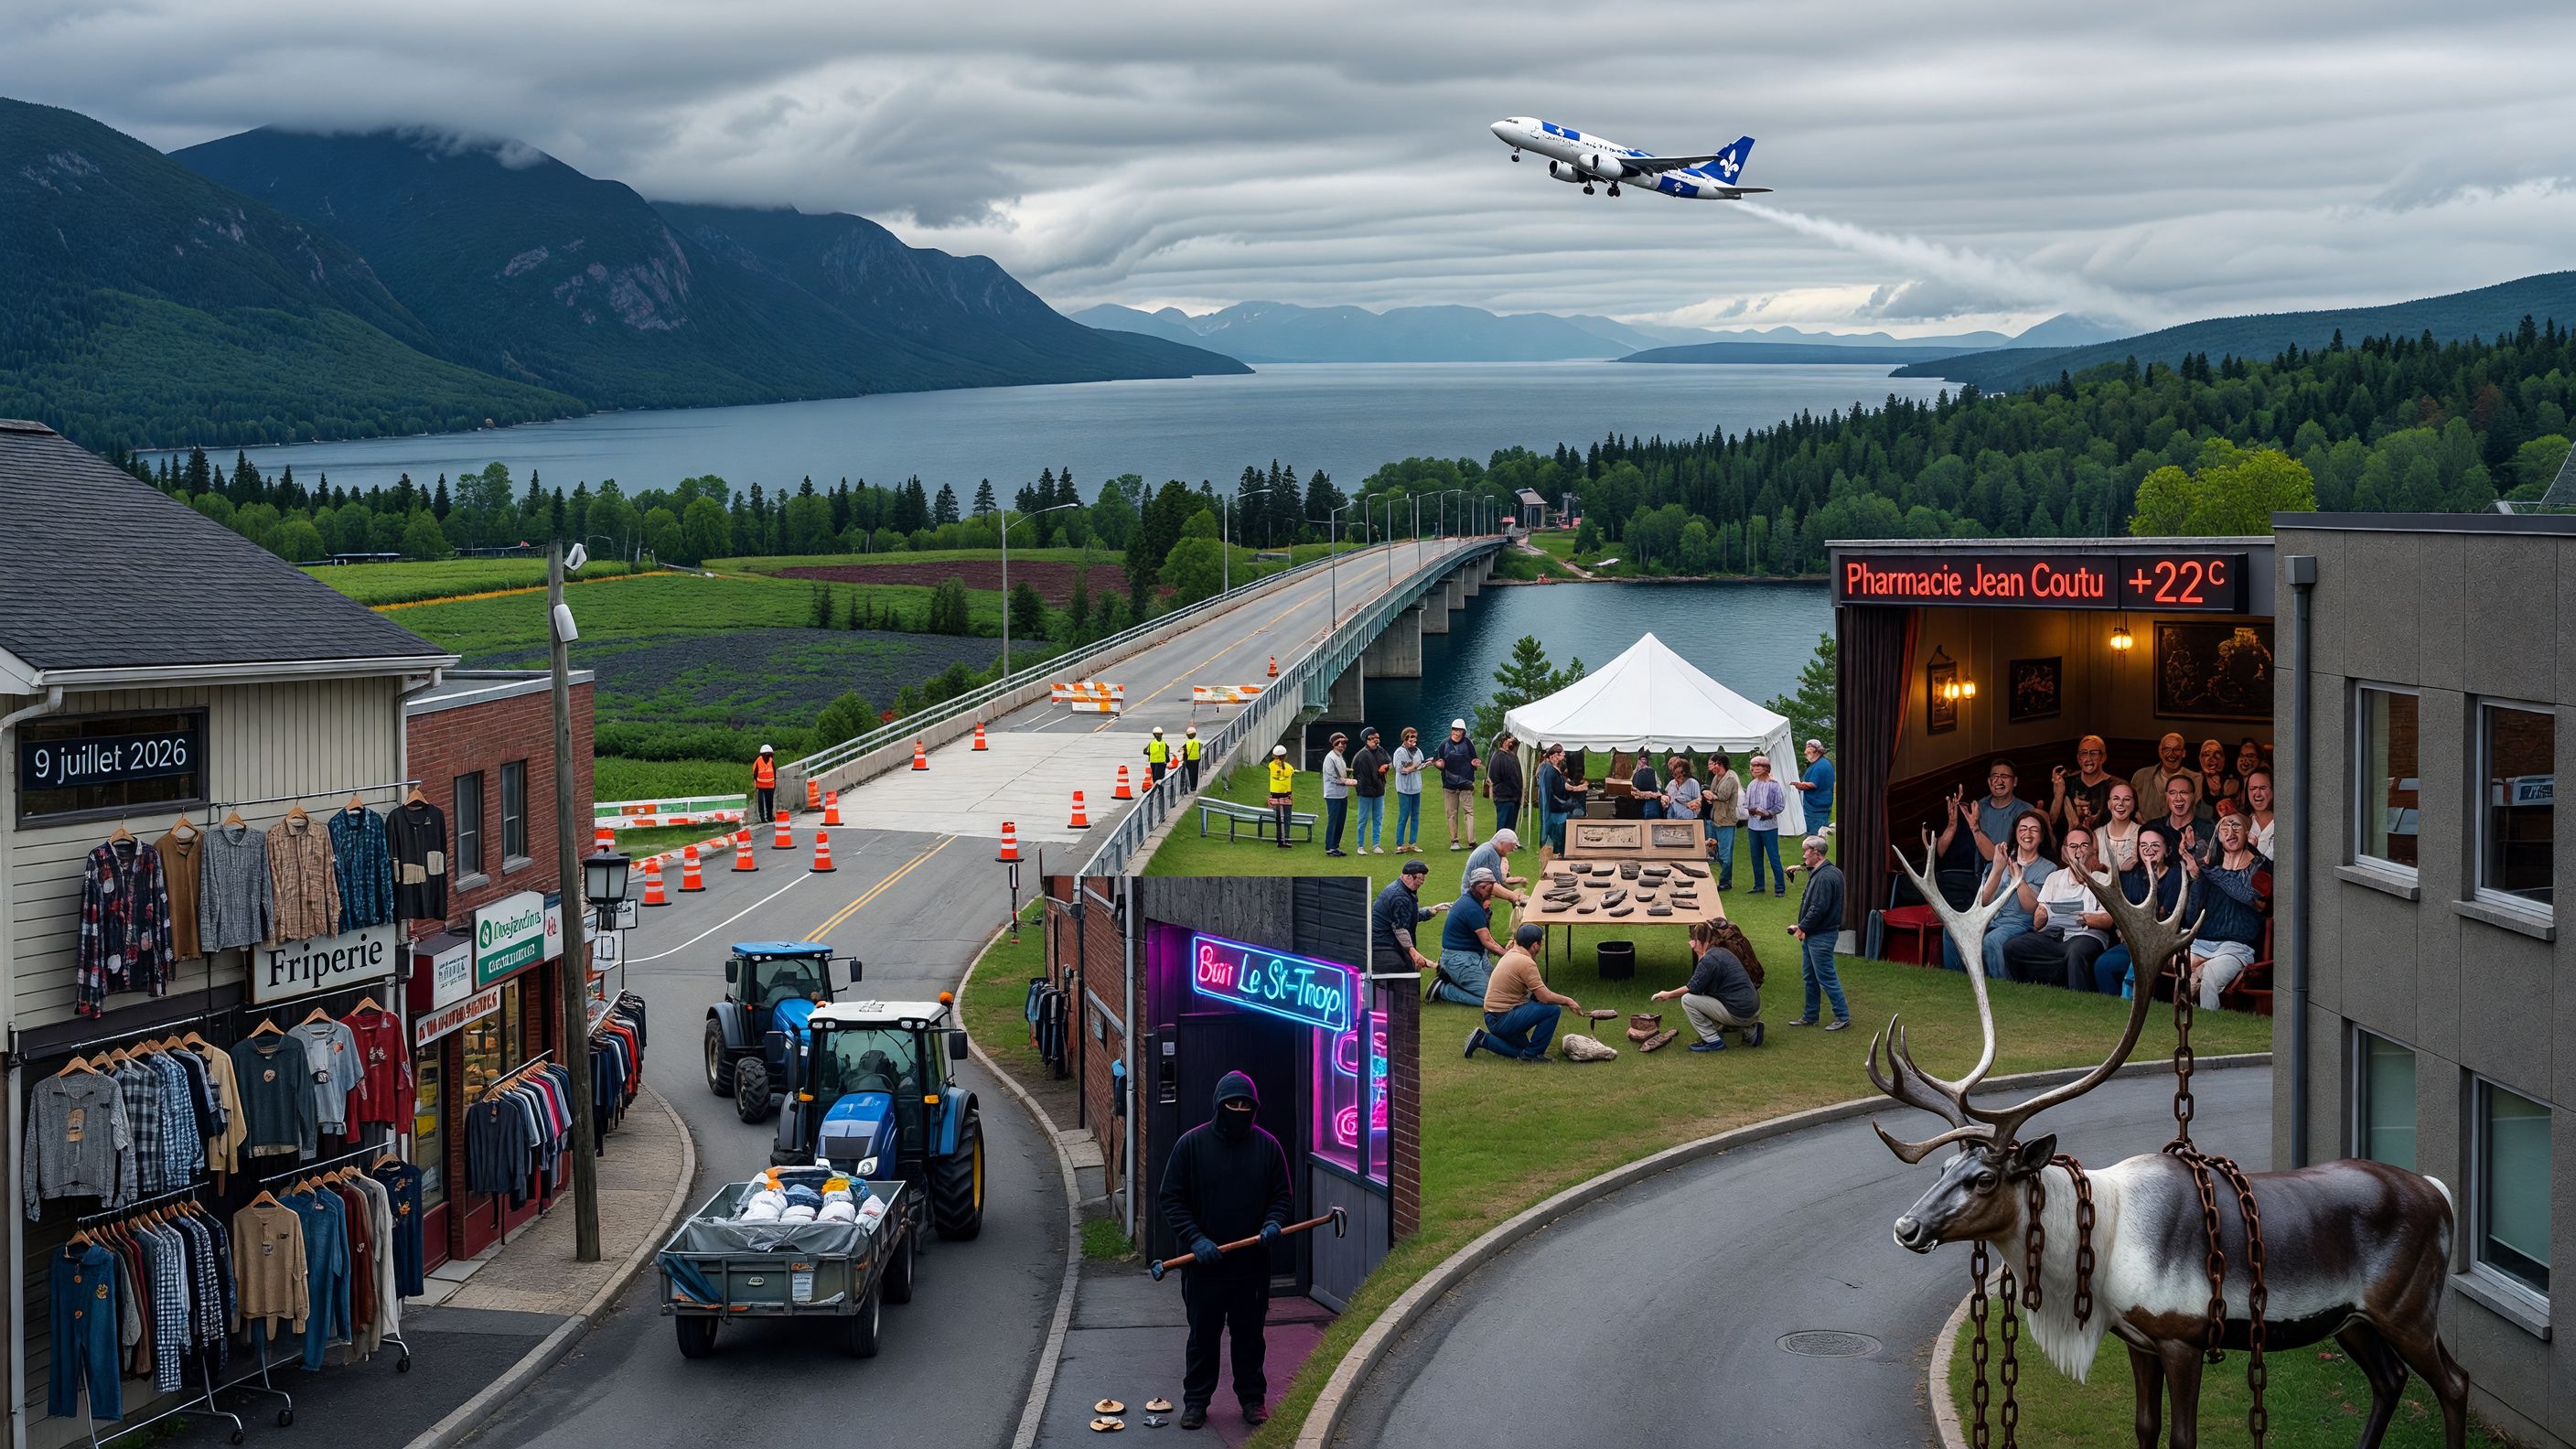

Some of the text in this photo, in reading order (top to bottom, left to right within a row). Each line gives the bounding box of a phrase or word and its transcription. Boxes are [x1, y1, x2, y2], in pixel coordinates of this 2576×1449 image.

[1847, 562, 2104, 597] Pharmacie Jean Coutu
[35, 738, 187, 785] 9 juillet 2026
[265, 933, 383, 989] Friperie
[1238, 953, 1261, 993] Le
